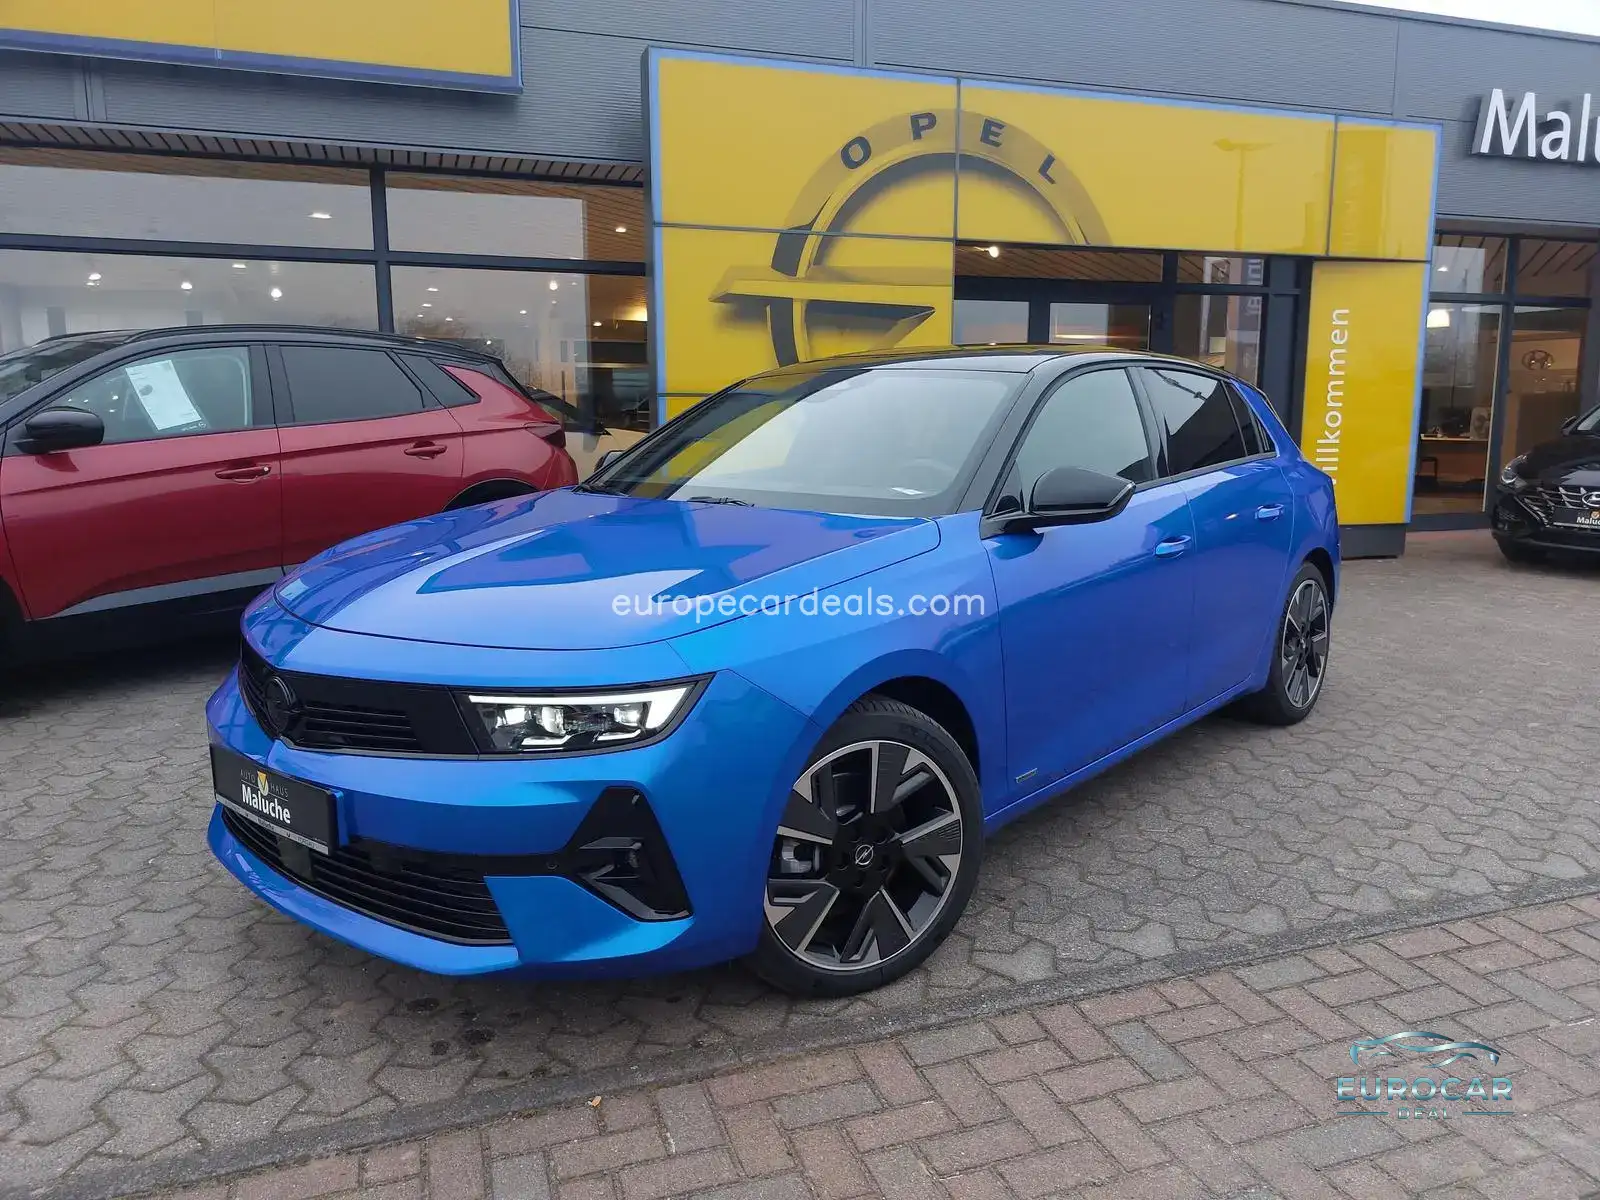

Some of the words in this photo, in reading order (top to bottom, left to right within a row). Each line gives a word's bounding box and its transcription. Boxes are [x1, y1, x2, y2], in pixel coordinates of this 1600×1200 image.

[840, 112, 1056, 185] OPEL
[1480, 88, 1600, 163] Mal
[1315, 308, 1350, 486] illkommen
[241, 783, 291, 824] Maluche
